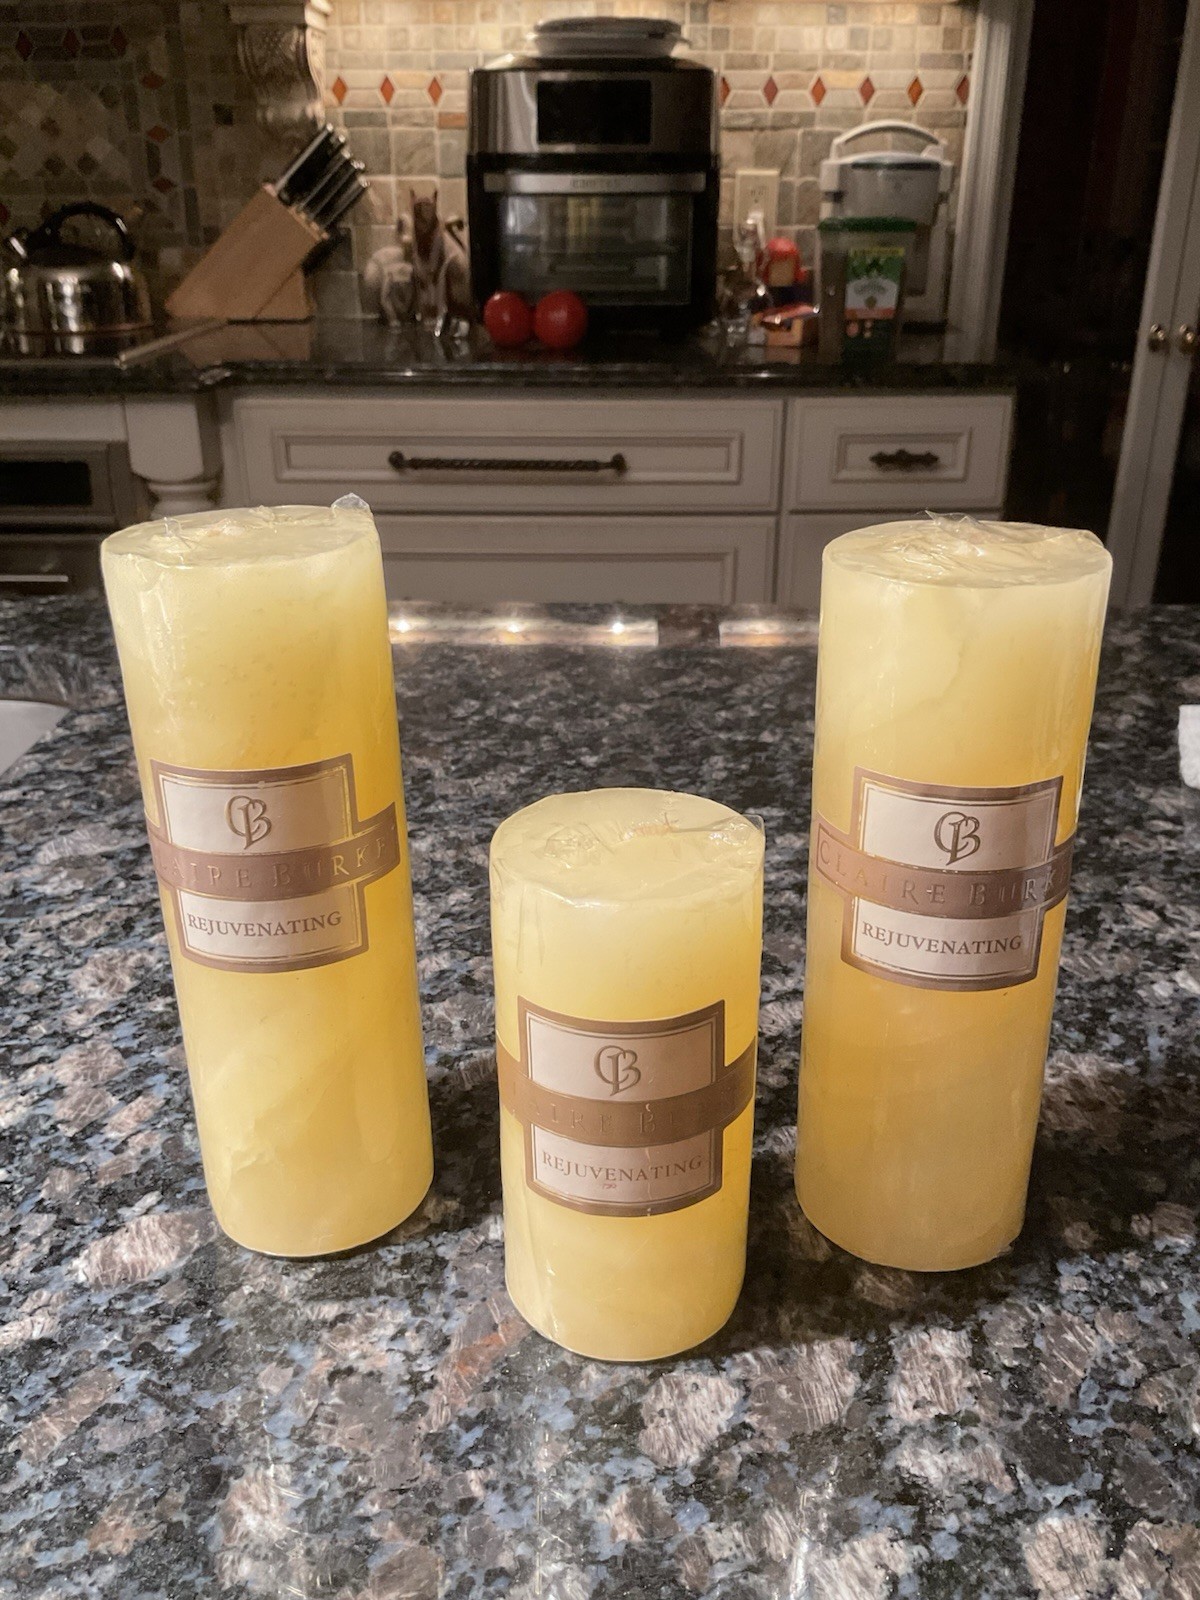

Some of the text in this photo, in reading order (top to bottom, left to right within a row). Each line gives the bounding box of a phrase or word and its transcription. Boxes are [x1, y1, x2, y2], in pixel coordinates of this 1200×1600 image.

[820, 840, 1067, 907] CLAIRE BURK
[187, 911, 343, 937] REJUVENATING
[861, 921, 1023, 956] REJUVENATING
[541, 1151, 703, 1182] REJUVENATING
